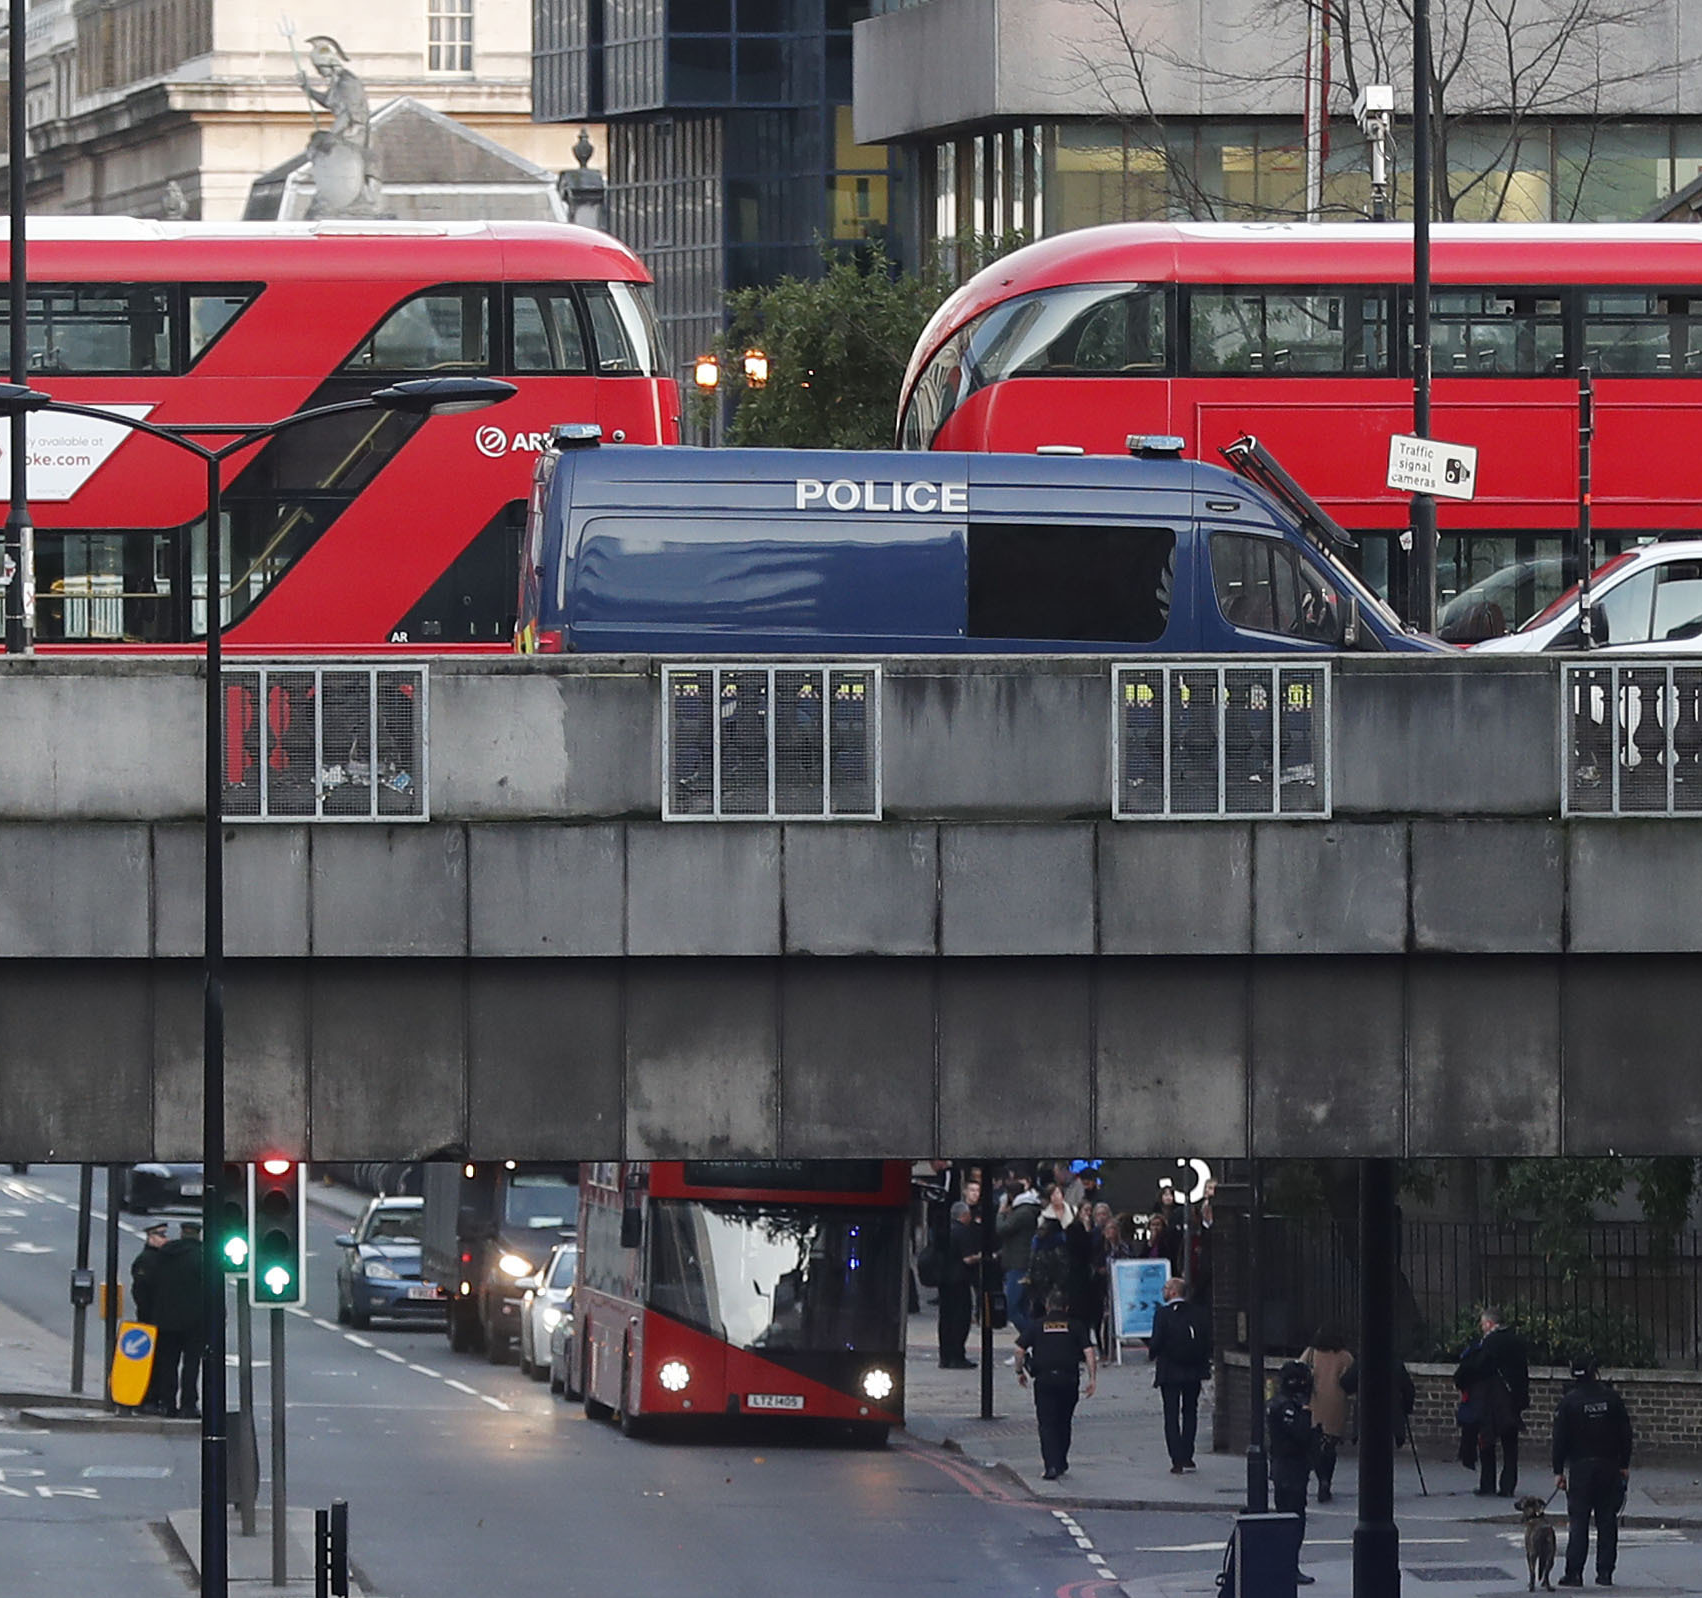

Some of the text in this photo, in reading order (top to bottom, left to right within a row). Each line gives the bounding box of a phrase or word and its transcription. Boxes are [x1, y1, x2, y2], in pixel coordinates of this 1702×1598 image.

[38, 436, 85, 447] available
[91, 438, 104, 447] at
[1399, 443, 1435, 459] Traffic
[25, 453, 92, 466] oke.com
[1399, 458, 1432, 474] signal
[1391, 474, 1437, 488] cameras
[795, 480, 969, 512] POLICE
[391, 631, 408, 643] AR
